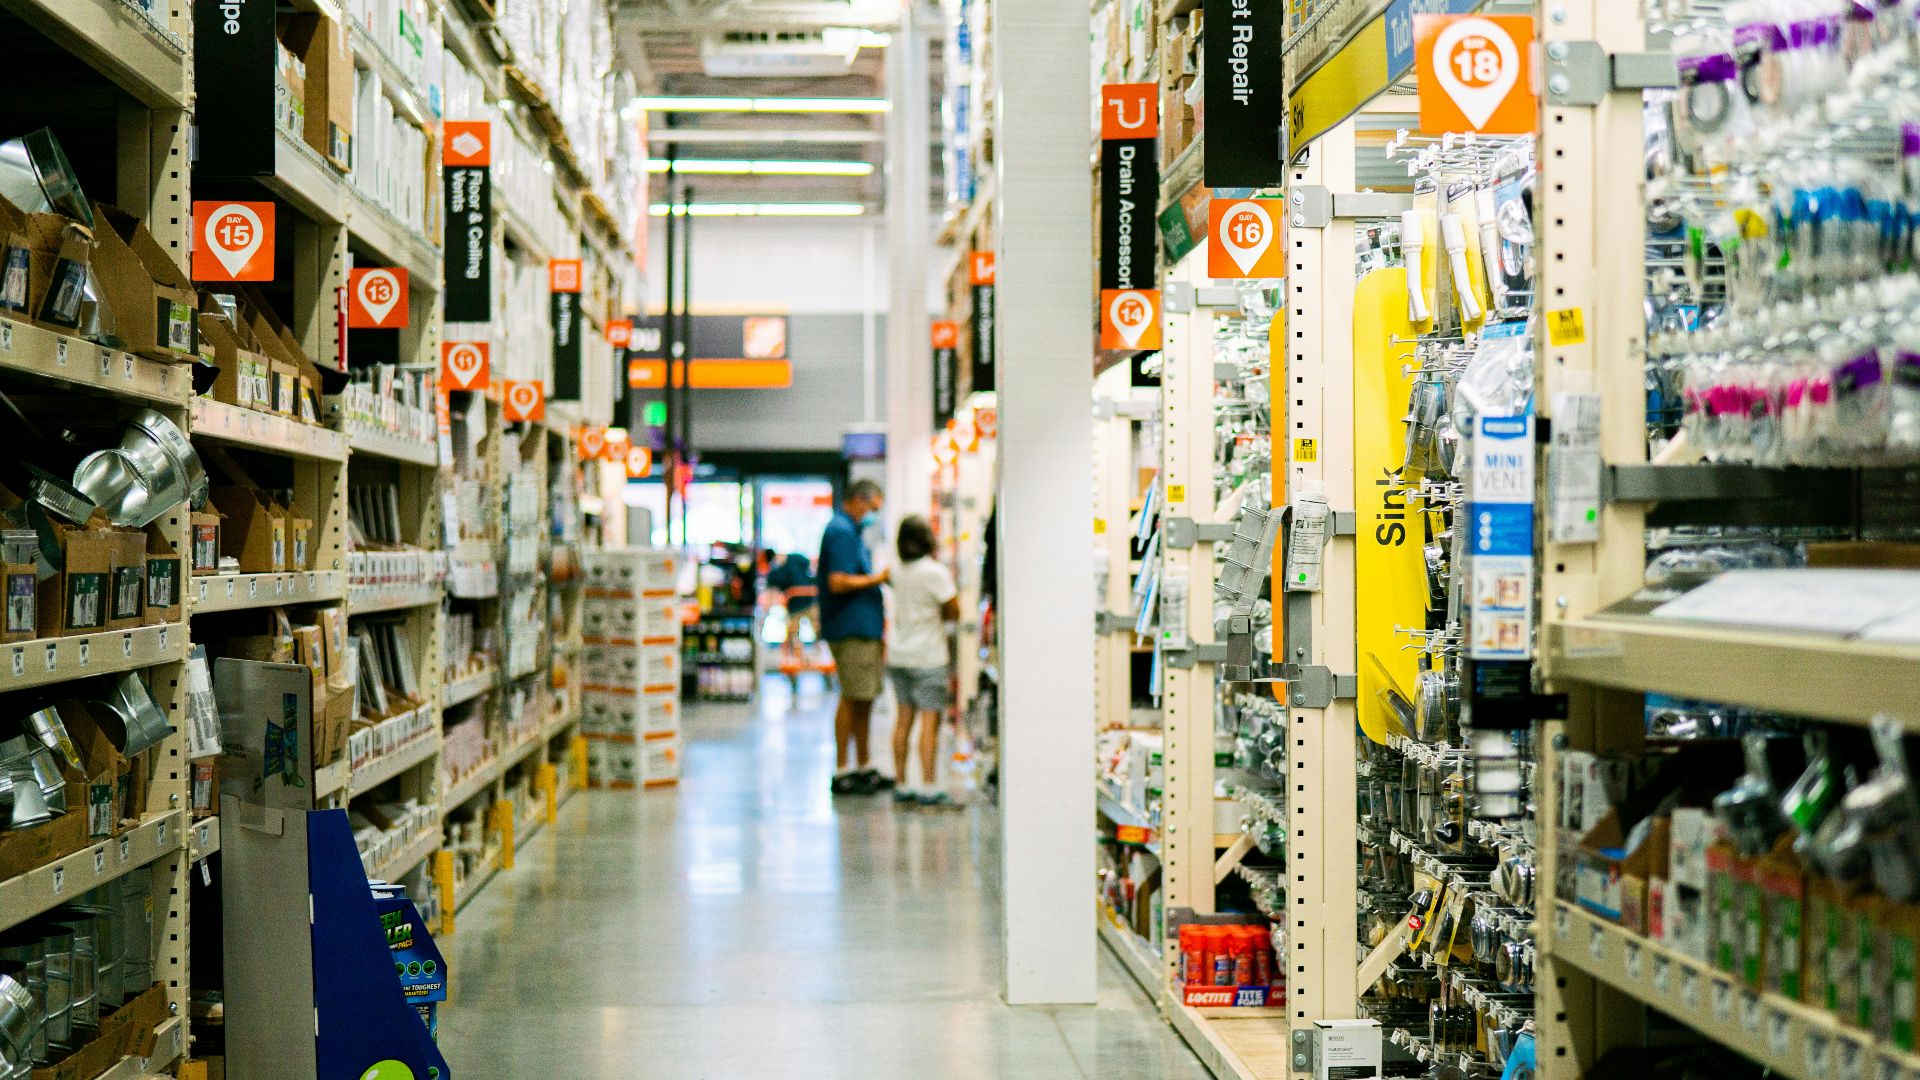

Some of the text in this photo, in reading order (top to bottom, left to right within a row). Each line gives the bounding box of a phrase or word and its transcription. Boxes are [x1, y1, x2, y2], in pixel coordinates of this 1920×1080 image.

[1227, 25, 1254, 106] Repair
[1454, 50, 1500, 83] 18
[1118, 146, 1136, 196] Drain
[452, 169, 467, 213] Vents
[226, 216, 243, 224] BAY
[464, 170, 484, 279] Floor & Ceiling
[220, 225, 250, 246] 15
[1232, 222, 1261, 243] 16
[368, 285, 391, 302] 13
[1120, 306, 1143, 323] 14
[1485, 454, 1523, 468] MINI
[1479, 471, 1527, 489] VENT
[1375, 465, 1406, 546] Sink
[411, 983, 441, 991] TOUGHEST
[1237, 990, 1263, 999] TITE
[1186, 992, 1233, 1003] LOCTITE
